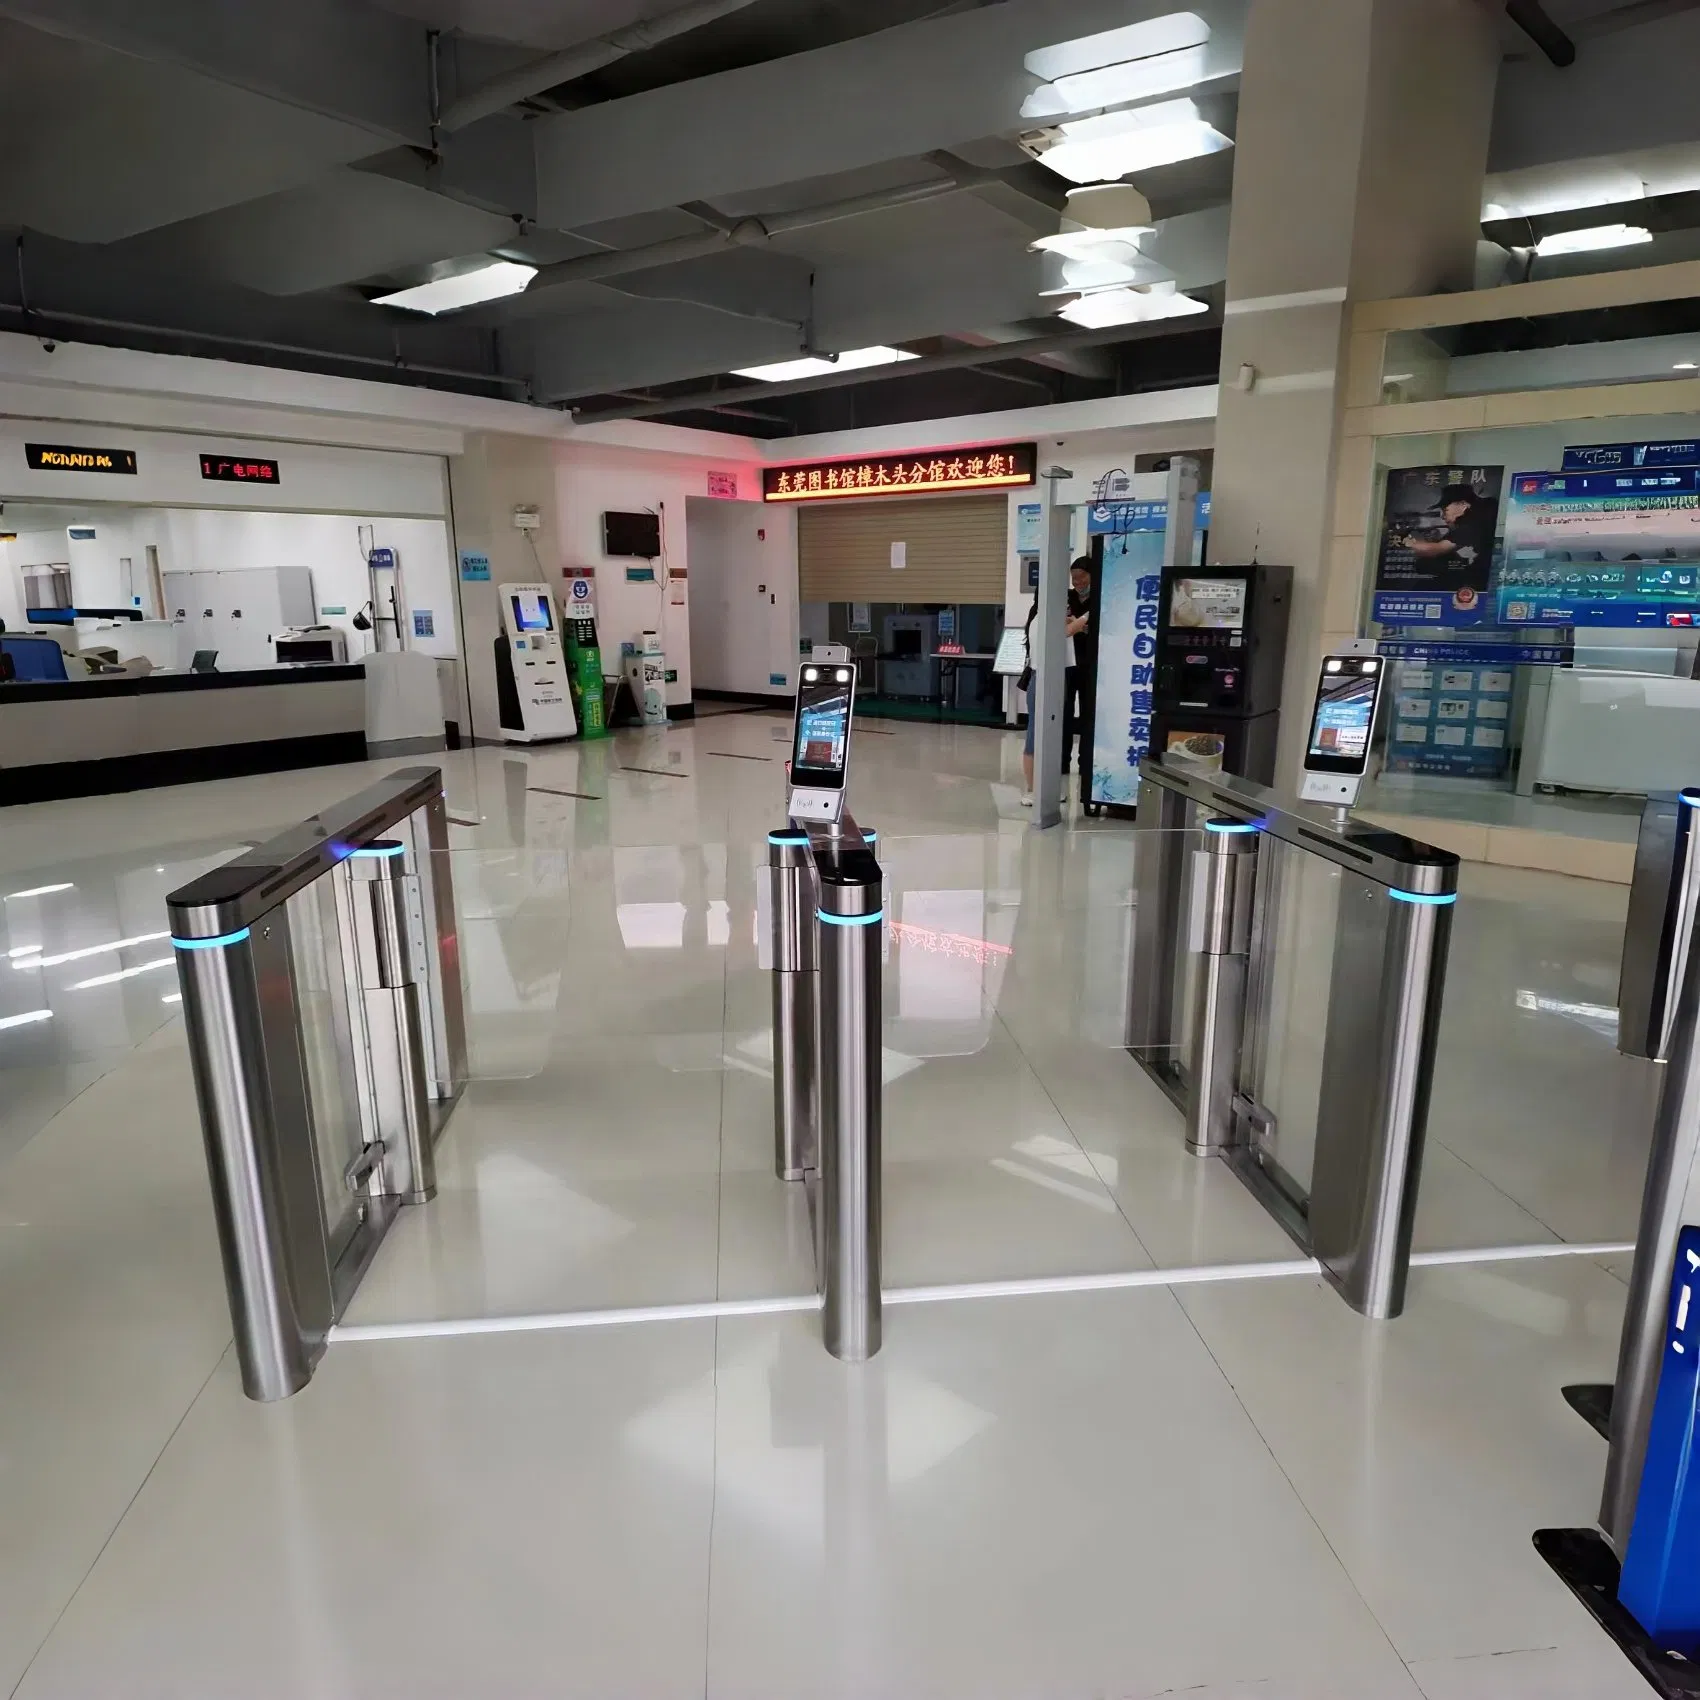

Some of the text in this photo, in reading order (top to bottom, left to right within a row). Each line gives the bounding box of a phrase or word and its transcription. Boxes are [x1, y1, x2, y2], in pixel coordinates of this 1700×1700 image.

[203, 462, 273, 478] 1 广电网络
[777, 453, 1015, 494] 东莞图书馆樟木头分馆欢迎您!
[1402, 468, 1487, 486] 广东警队
